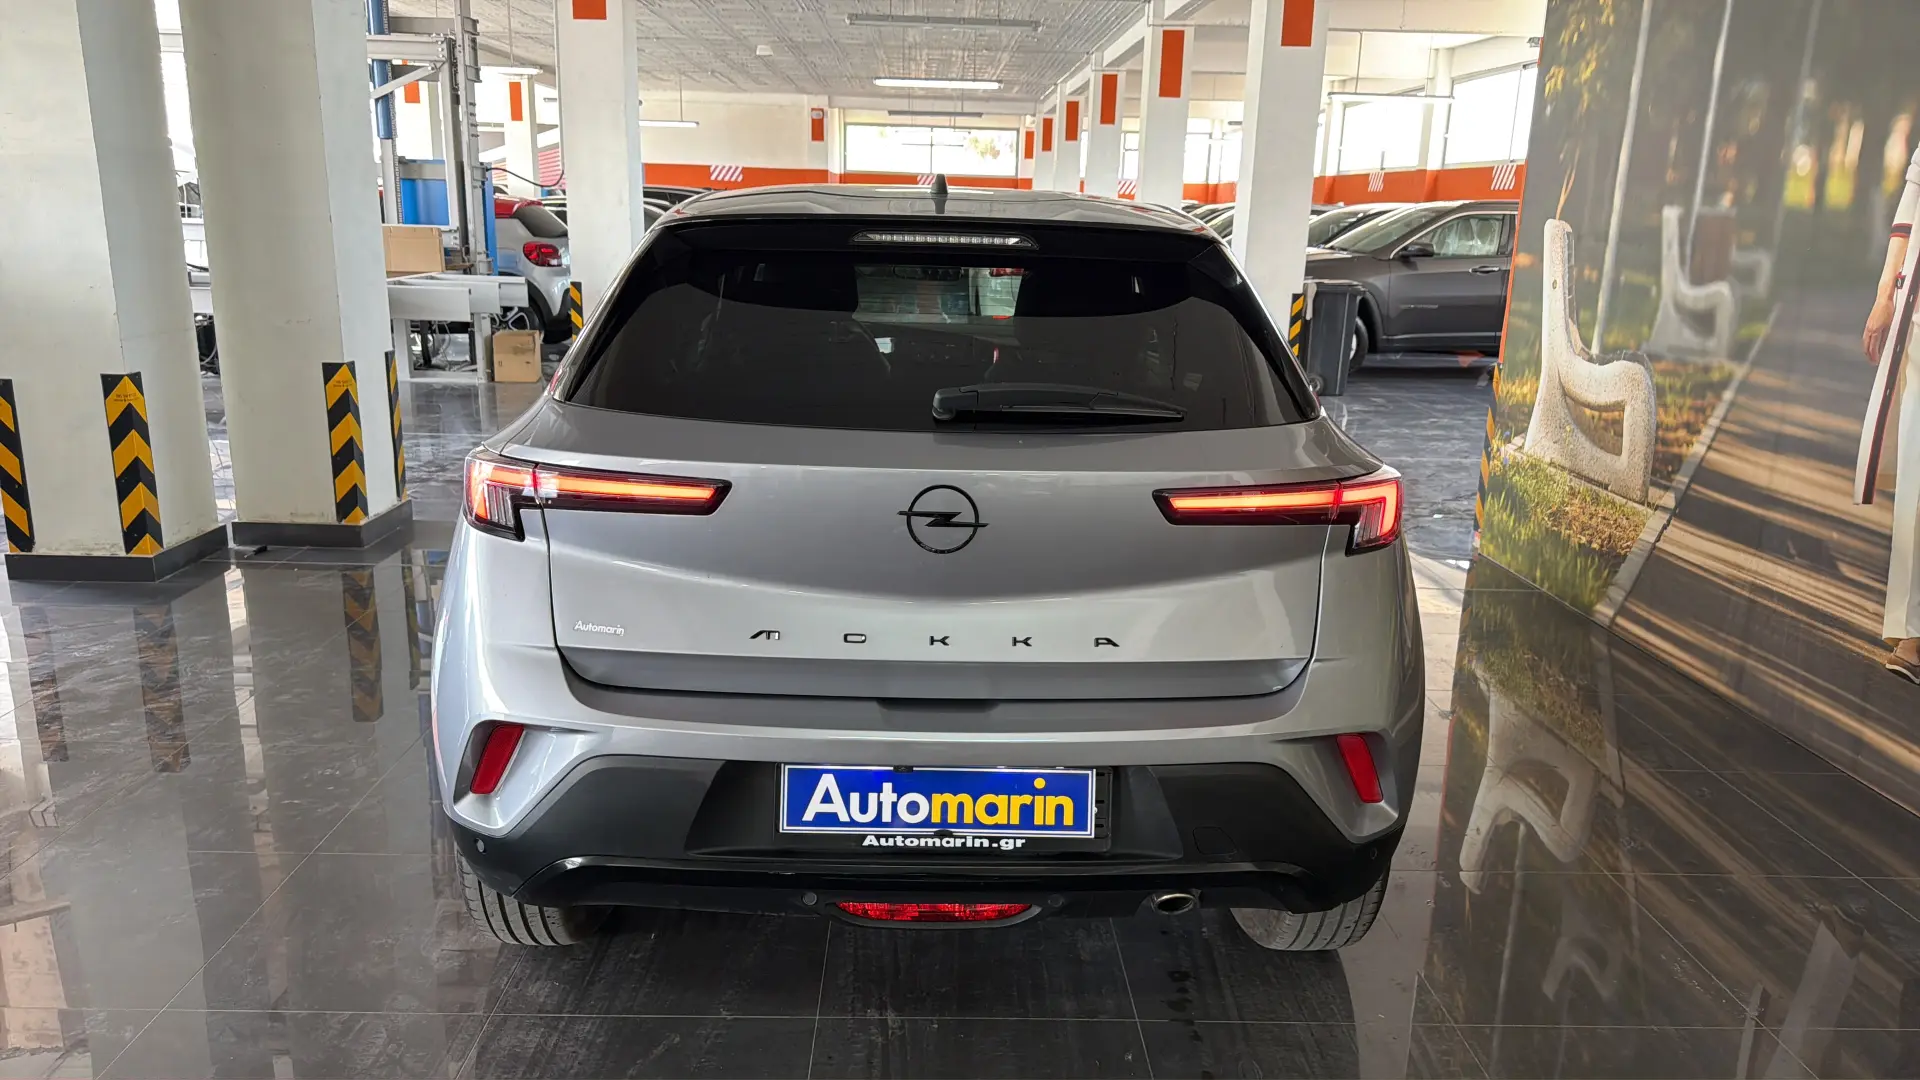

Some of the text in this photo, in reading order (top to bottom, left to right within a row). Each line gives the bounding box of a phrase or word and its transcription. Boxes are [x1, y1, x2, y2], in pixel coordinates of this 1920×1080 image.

[573, 620, 625, 636] Automarin
[749, 629, 1120, 648] MOKKA
[801, 773, 1074, 826] Automarin
[862, 834, 1026, 850] Automarin.gr
